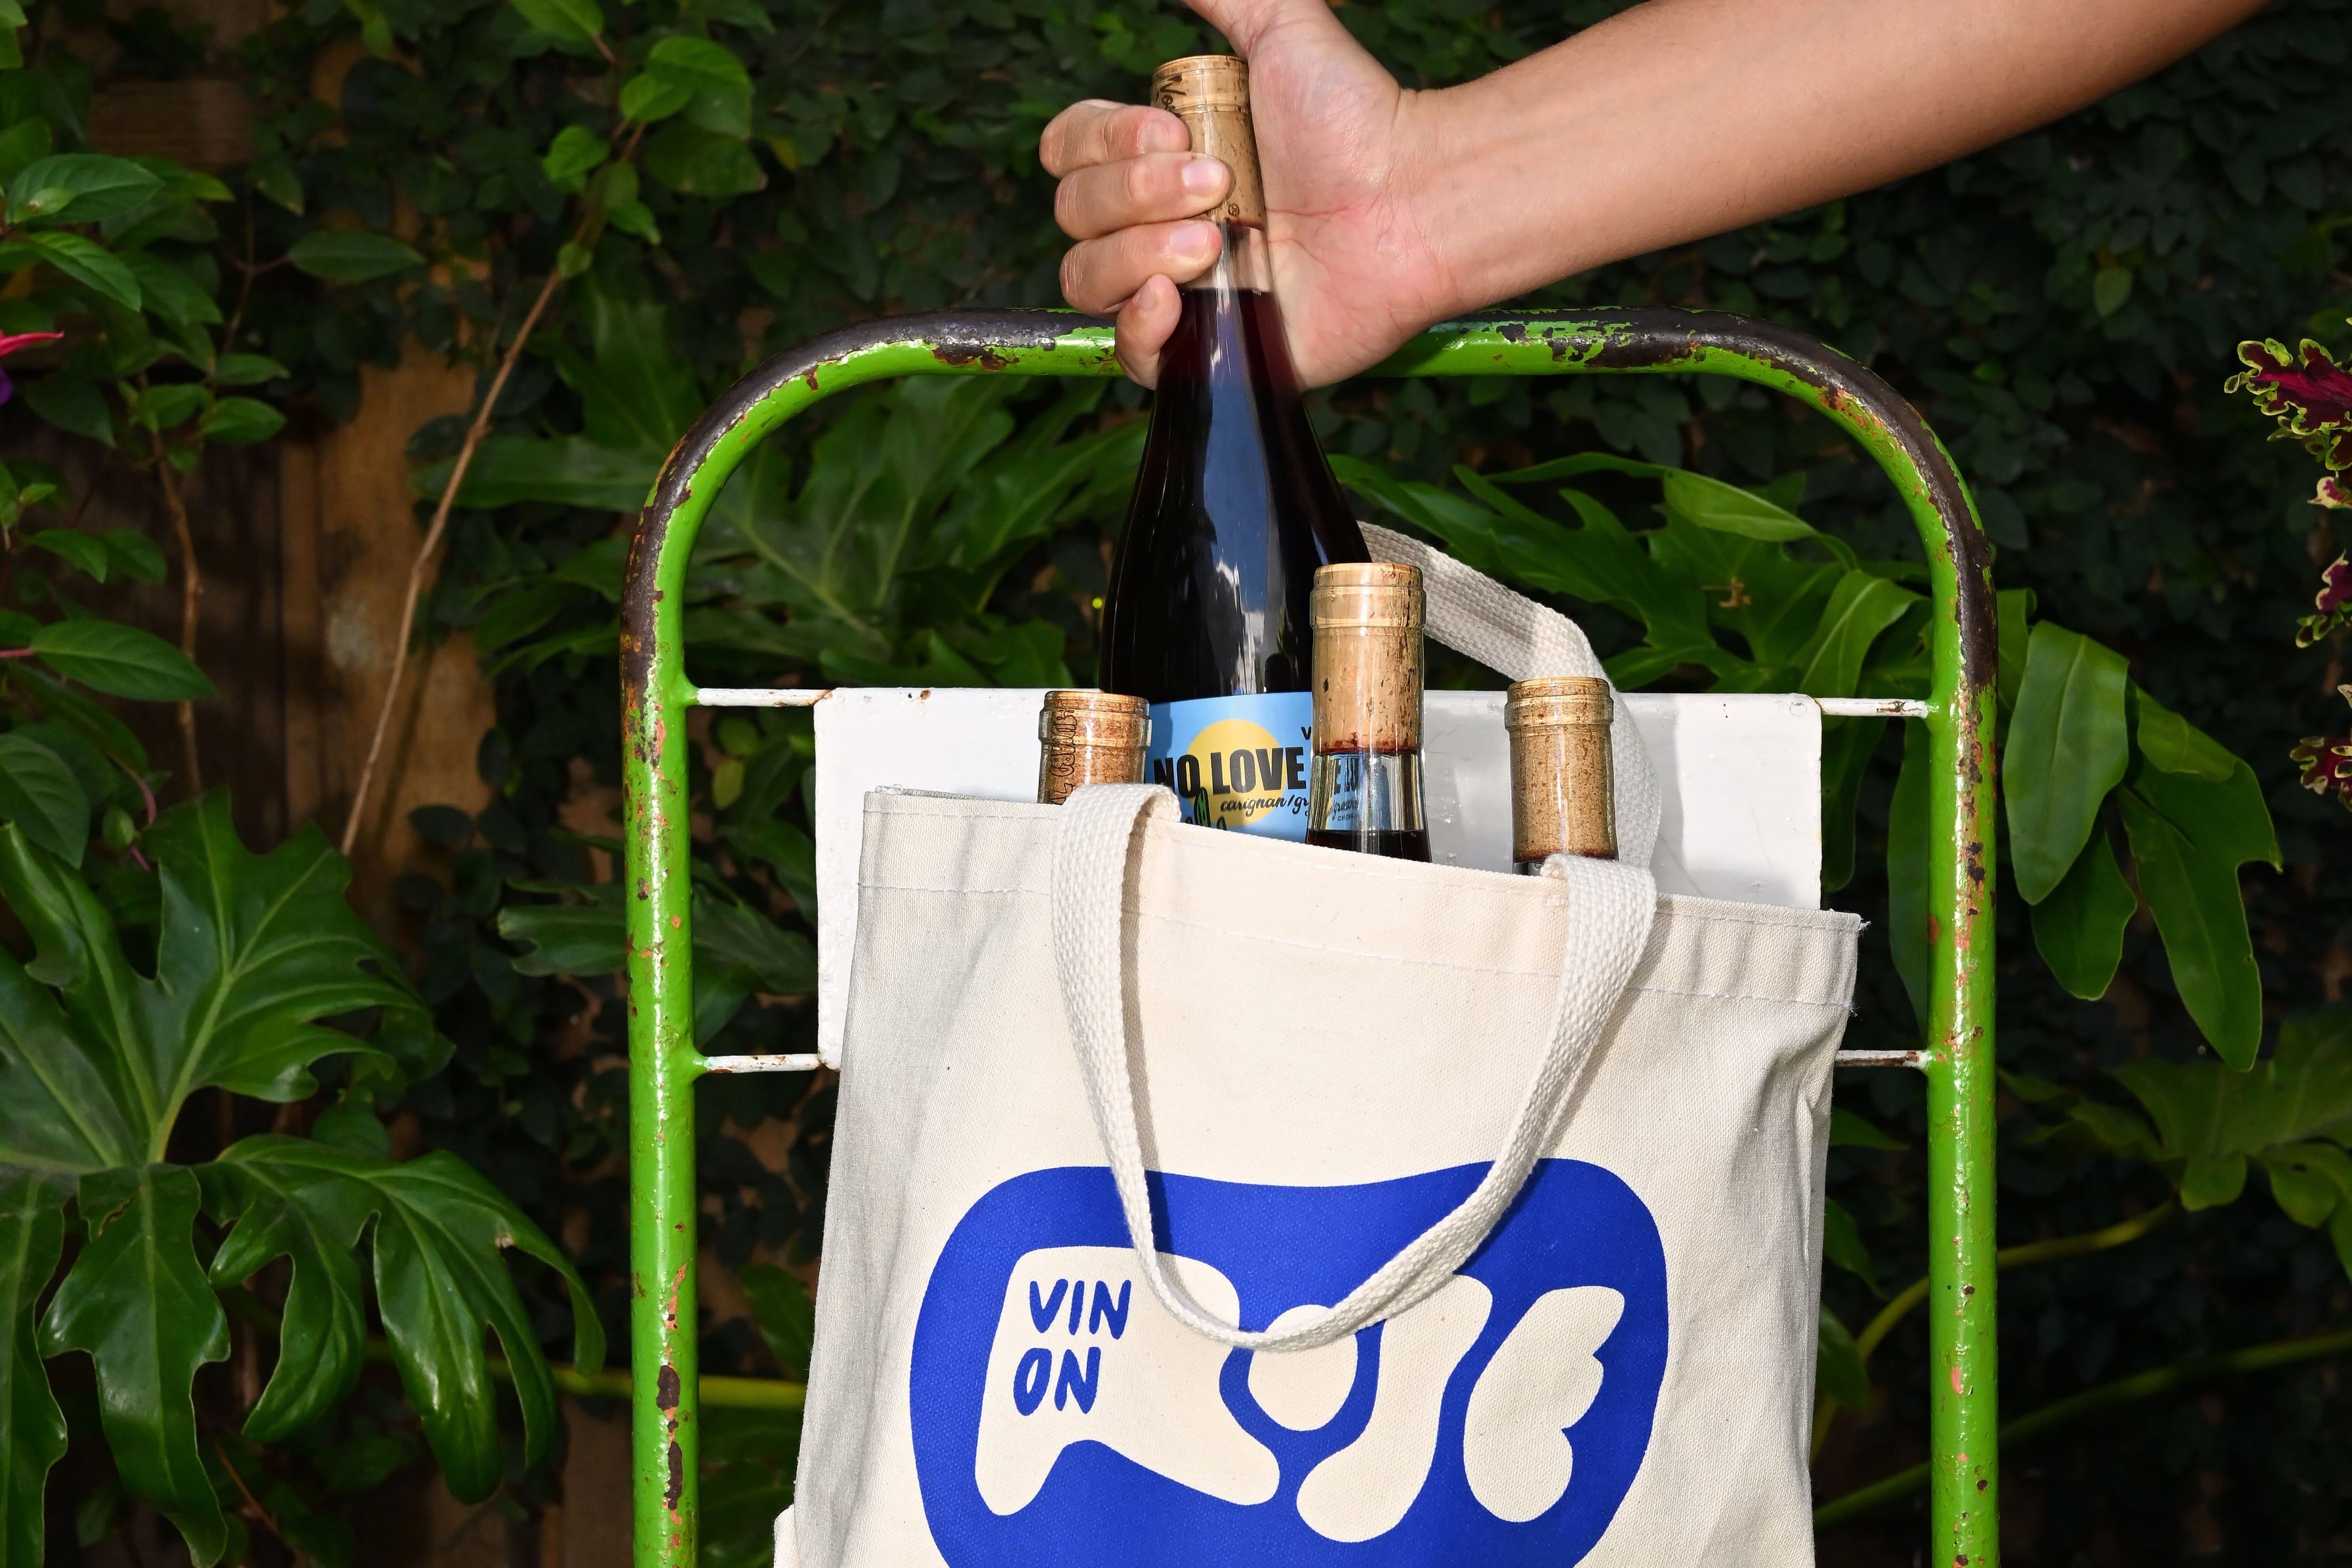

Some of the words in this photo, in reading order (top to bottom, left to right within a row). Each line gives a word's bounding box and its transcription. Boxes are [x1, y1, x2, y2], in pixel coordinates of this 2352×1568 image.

[1153, 754, 1201, 798] NO
[1210, 746, 1307, 795] LOVE
[1029, 1278, 1132, 1340] VIN
[1013, 1346, 1102, 1417] ON
